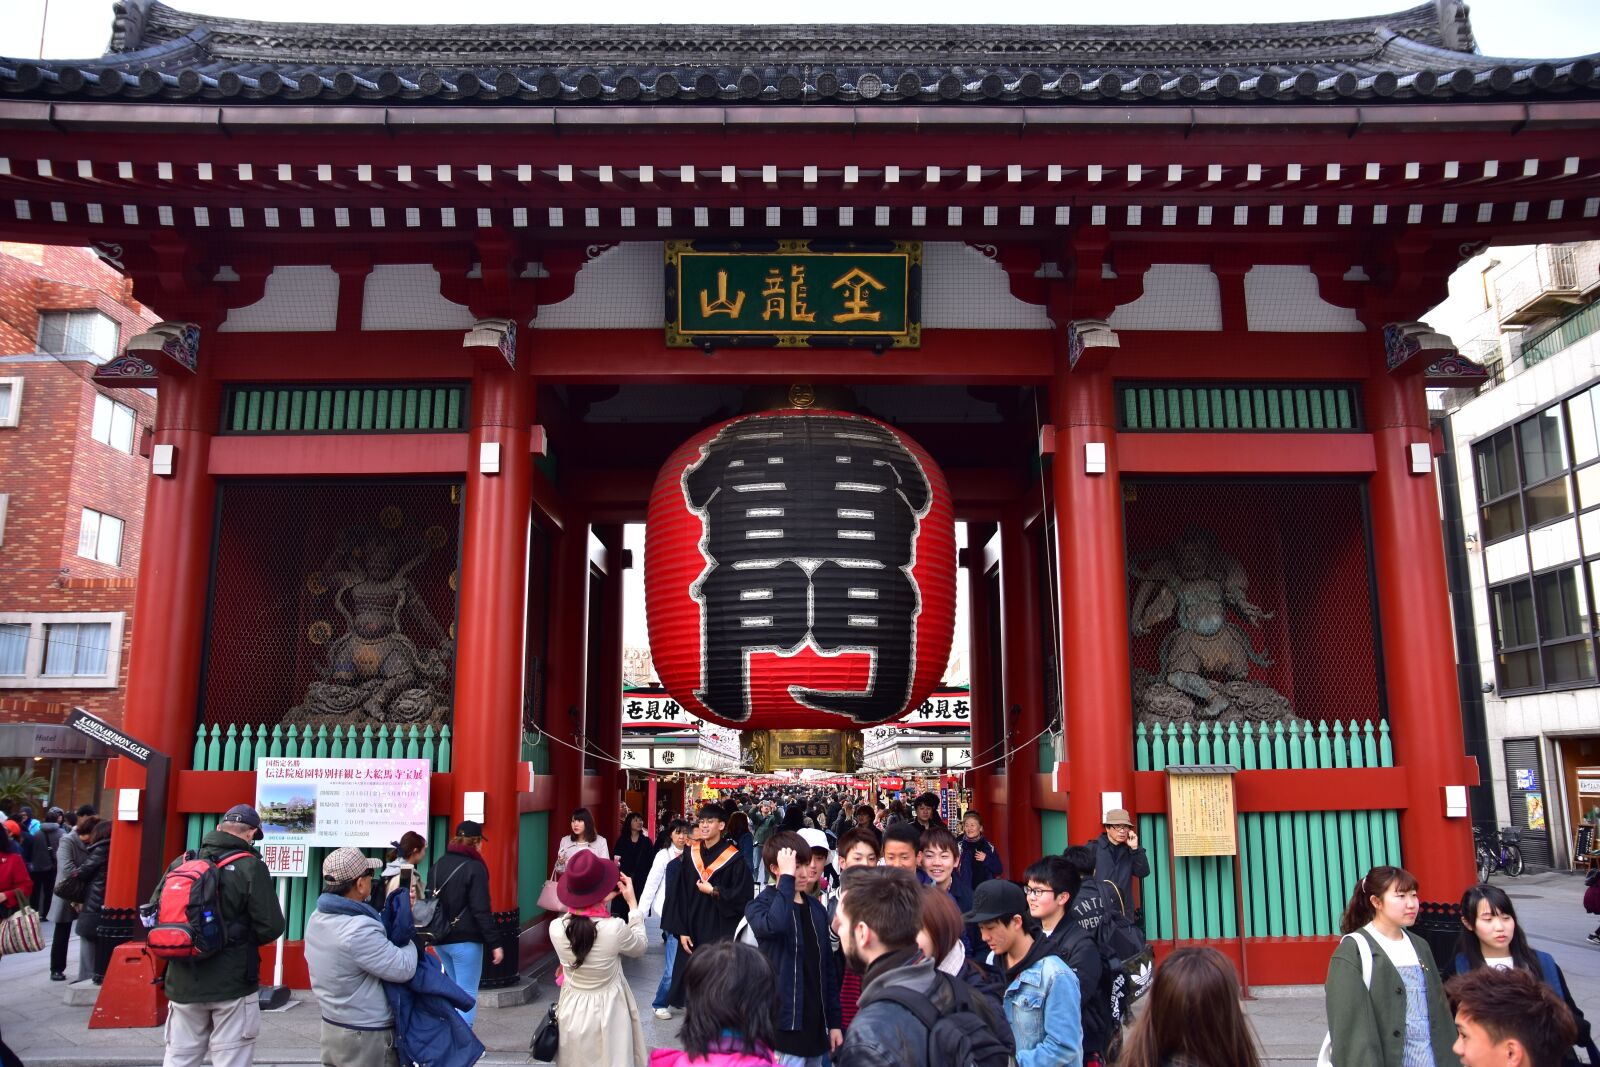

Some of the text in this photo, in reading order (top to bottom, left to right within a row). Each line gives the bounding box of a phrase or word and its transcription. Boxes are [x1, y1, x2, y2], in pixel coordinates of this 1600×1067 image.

[918, 699, 969, 720] 仲見世
[79, 716, 132, 747] KAMINARIMON
[129, 743, 151, 757] GATE
[265, 845, 303, 871] 開催中
